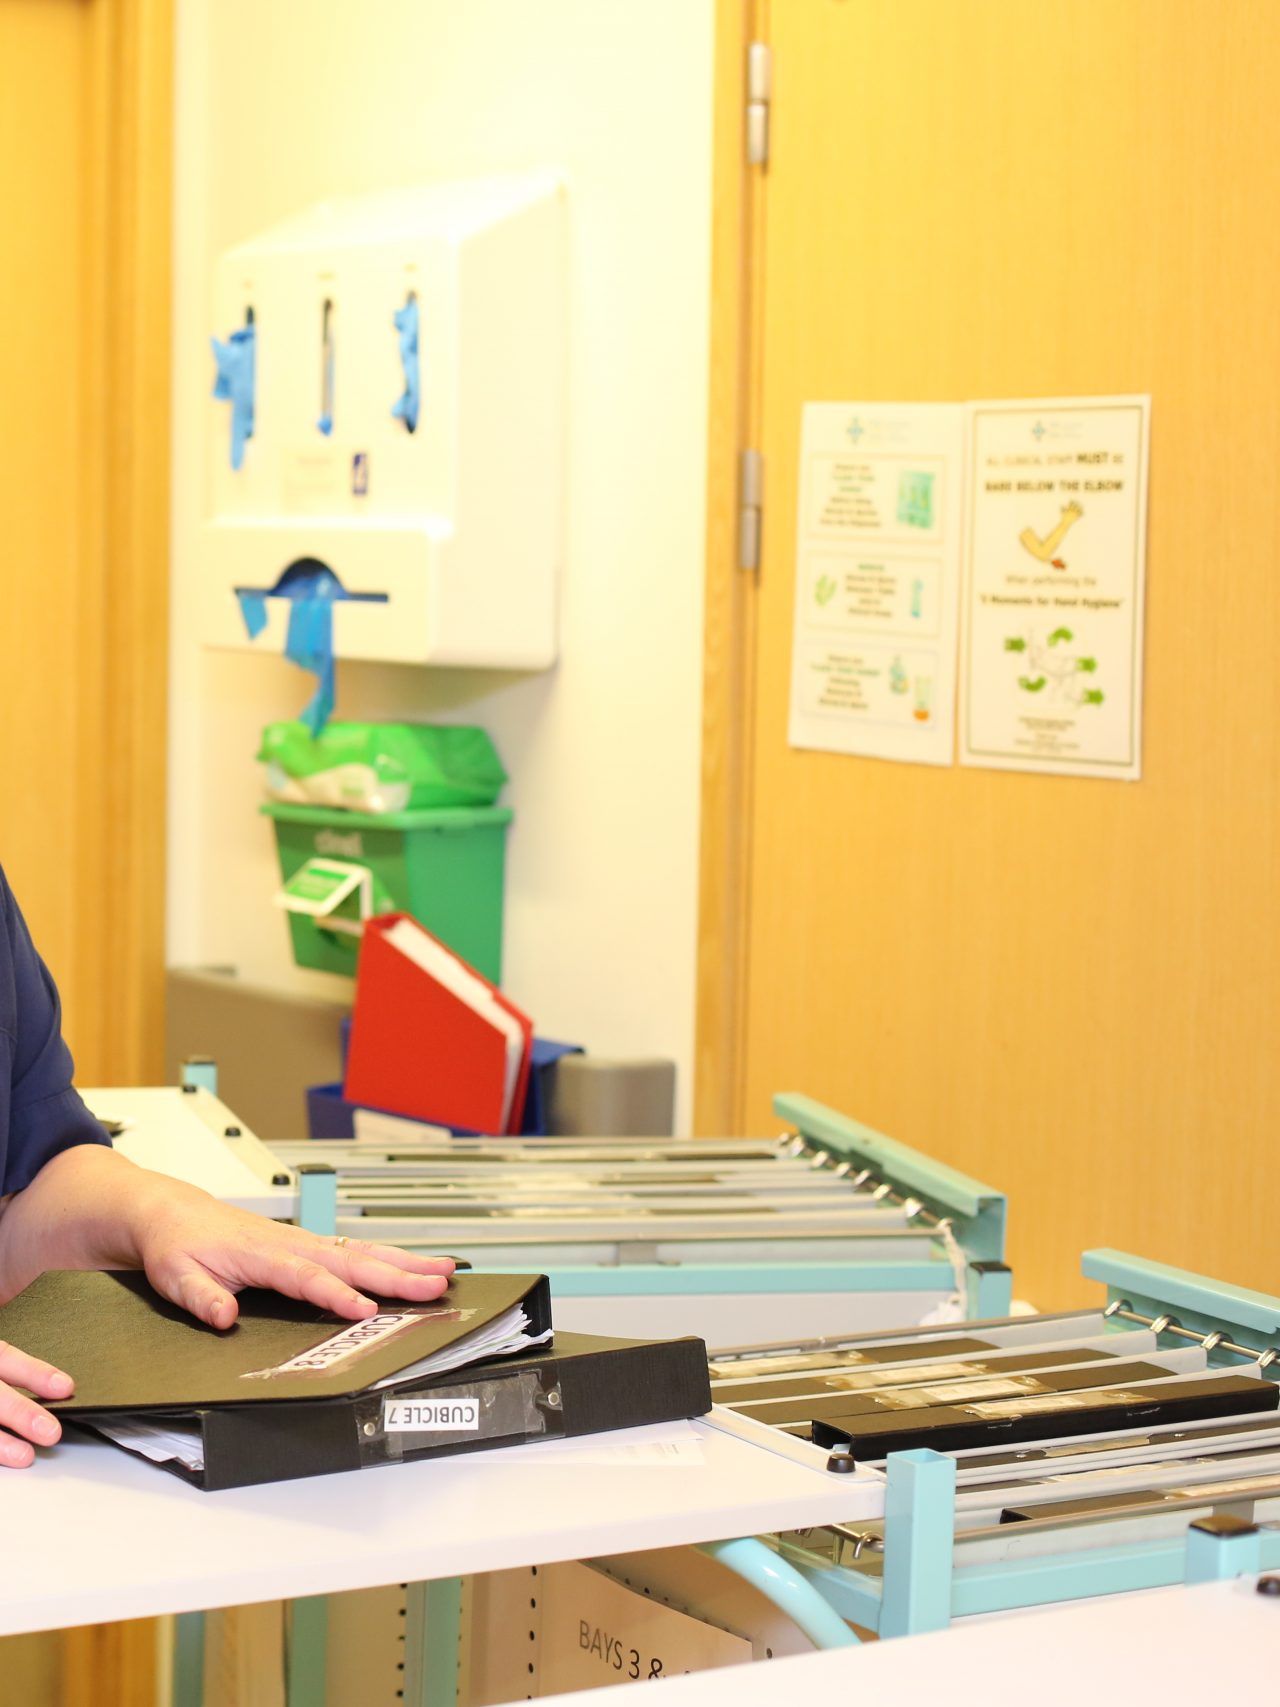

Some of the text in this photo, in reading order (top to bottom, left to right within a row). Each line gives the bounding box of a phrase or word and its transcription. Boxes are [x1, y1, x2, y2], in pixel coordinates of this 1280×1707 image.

[1077, 452, 1109, 464] MUST
[1017, 481, 1054, 492] BELOW
[1059, 481, 1080, 492] THE
[1083, 480, 1124, 492] ELBOW
[294, 1315, 403, 1368] CUBICLE 8
[388, 1406, 475, 1424] CUBICLE 7
[579, 1619, 667, 1680] BAYS 3 &
